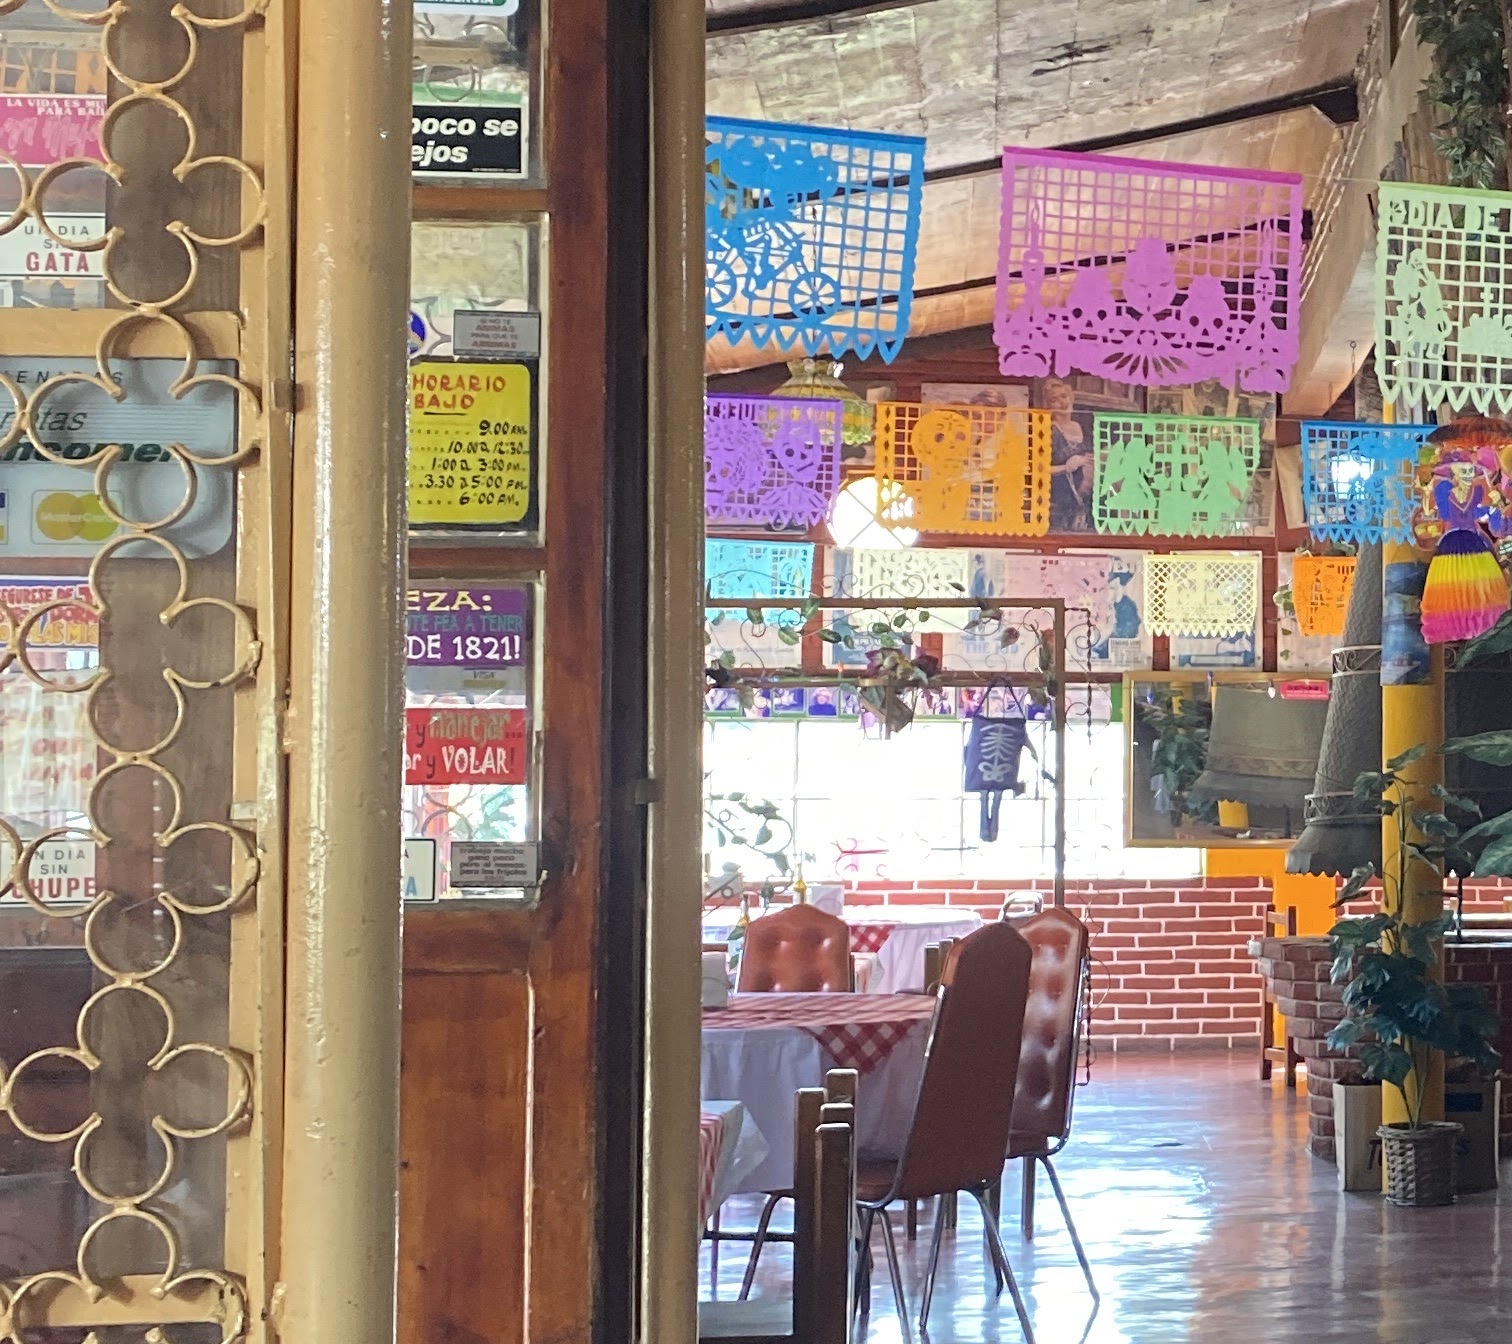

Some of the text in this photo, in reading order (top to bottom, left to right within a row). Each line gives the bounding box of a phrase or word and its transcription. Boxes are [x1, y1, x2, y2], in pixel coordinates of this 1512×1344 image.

[37, 107, 72, 116] PARA
[482, 118, 519, 136] se
[1407, 199, 1455, 229] DIA
[1465, 203, 1500, 233] DE
[58, 225, 90, 236] DIA
[26, 251, 90, 272] GATA
[412, 373, 506, 393] HORARIO
[414, 393, 475, 410] BAJO
[452, 634, 520, 661] 1821!
[441, 744, 515, 775] VOLAR!
[54, 849, 86, 861] DIA
[40, 863, 68, 875] SIN
